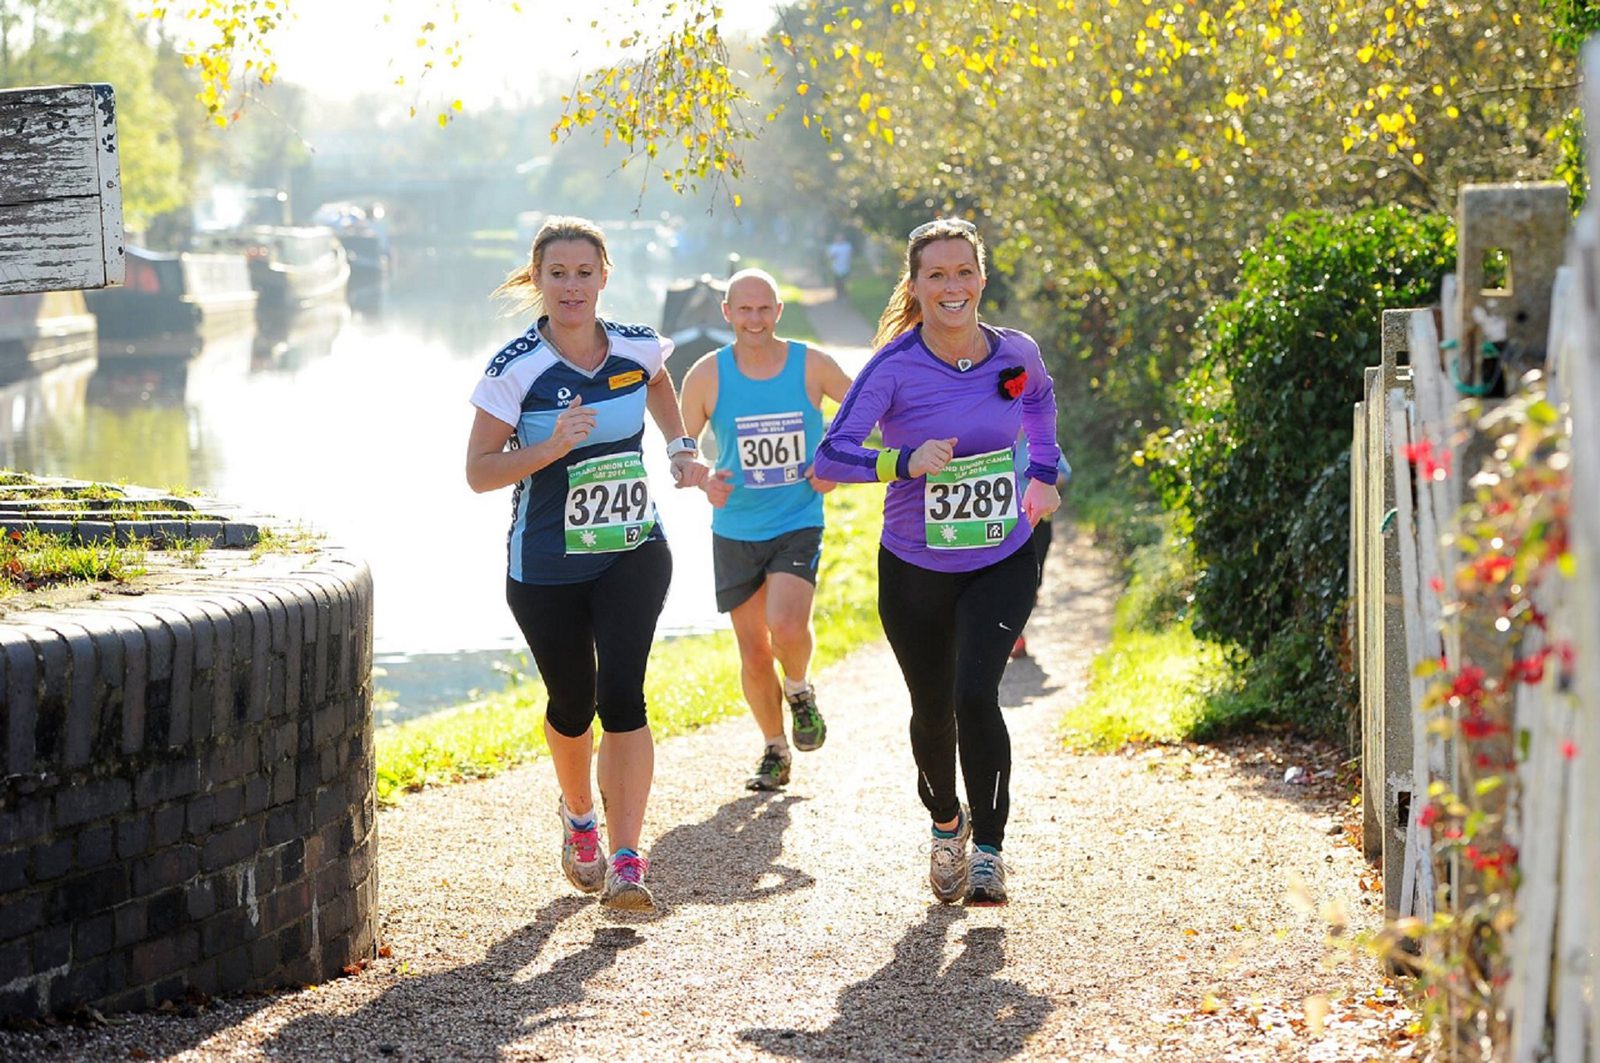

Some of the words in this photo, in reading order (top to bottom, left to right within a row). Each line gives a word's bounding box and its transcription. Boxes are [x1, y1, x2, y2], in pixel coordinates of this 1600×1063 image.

[744, 435, 800, 467] 3061
[986, 454, 1012, 464] CANAL
[597, 462, 623, 472] UNION
[968, 466, 987, 475] 2014
[607, 469, 626, 478] 2014
[930, 476, 1013, 520] 3289
[568, 481, 648, 526] 3249
